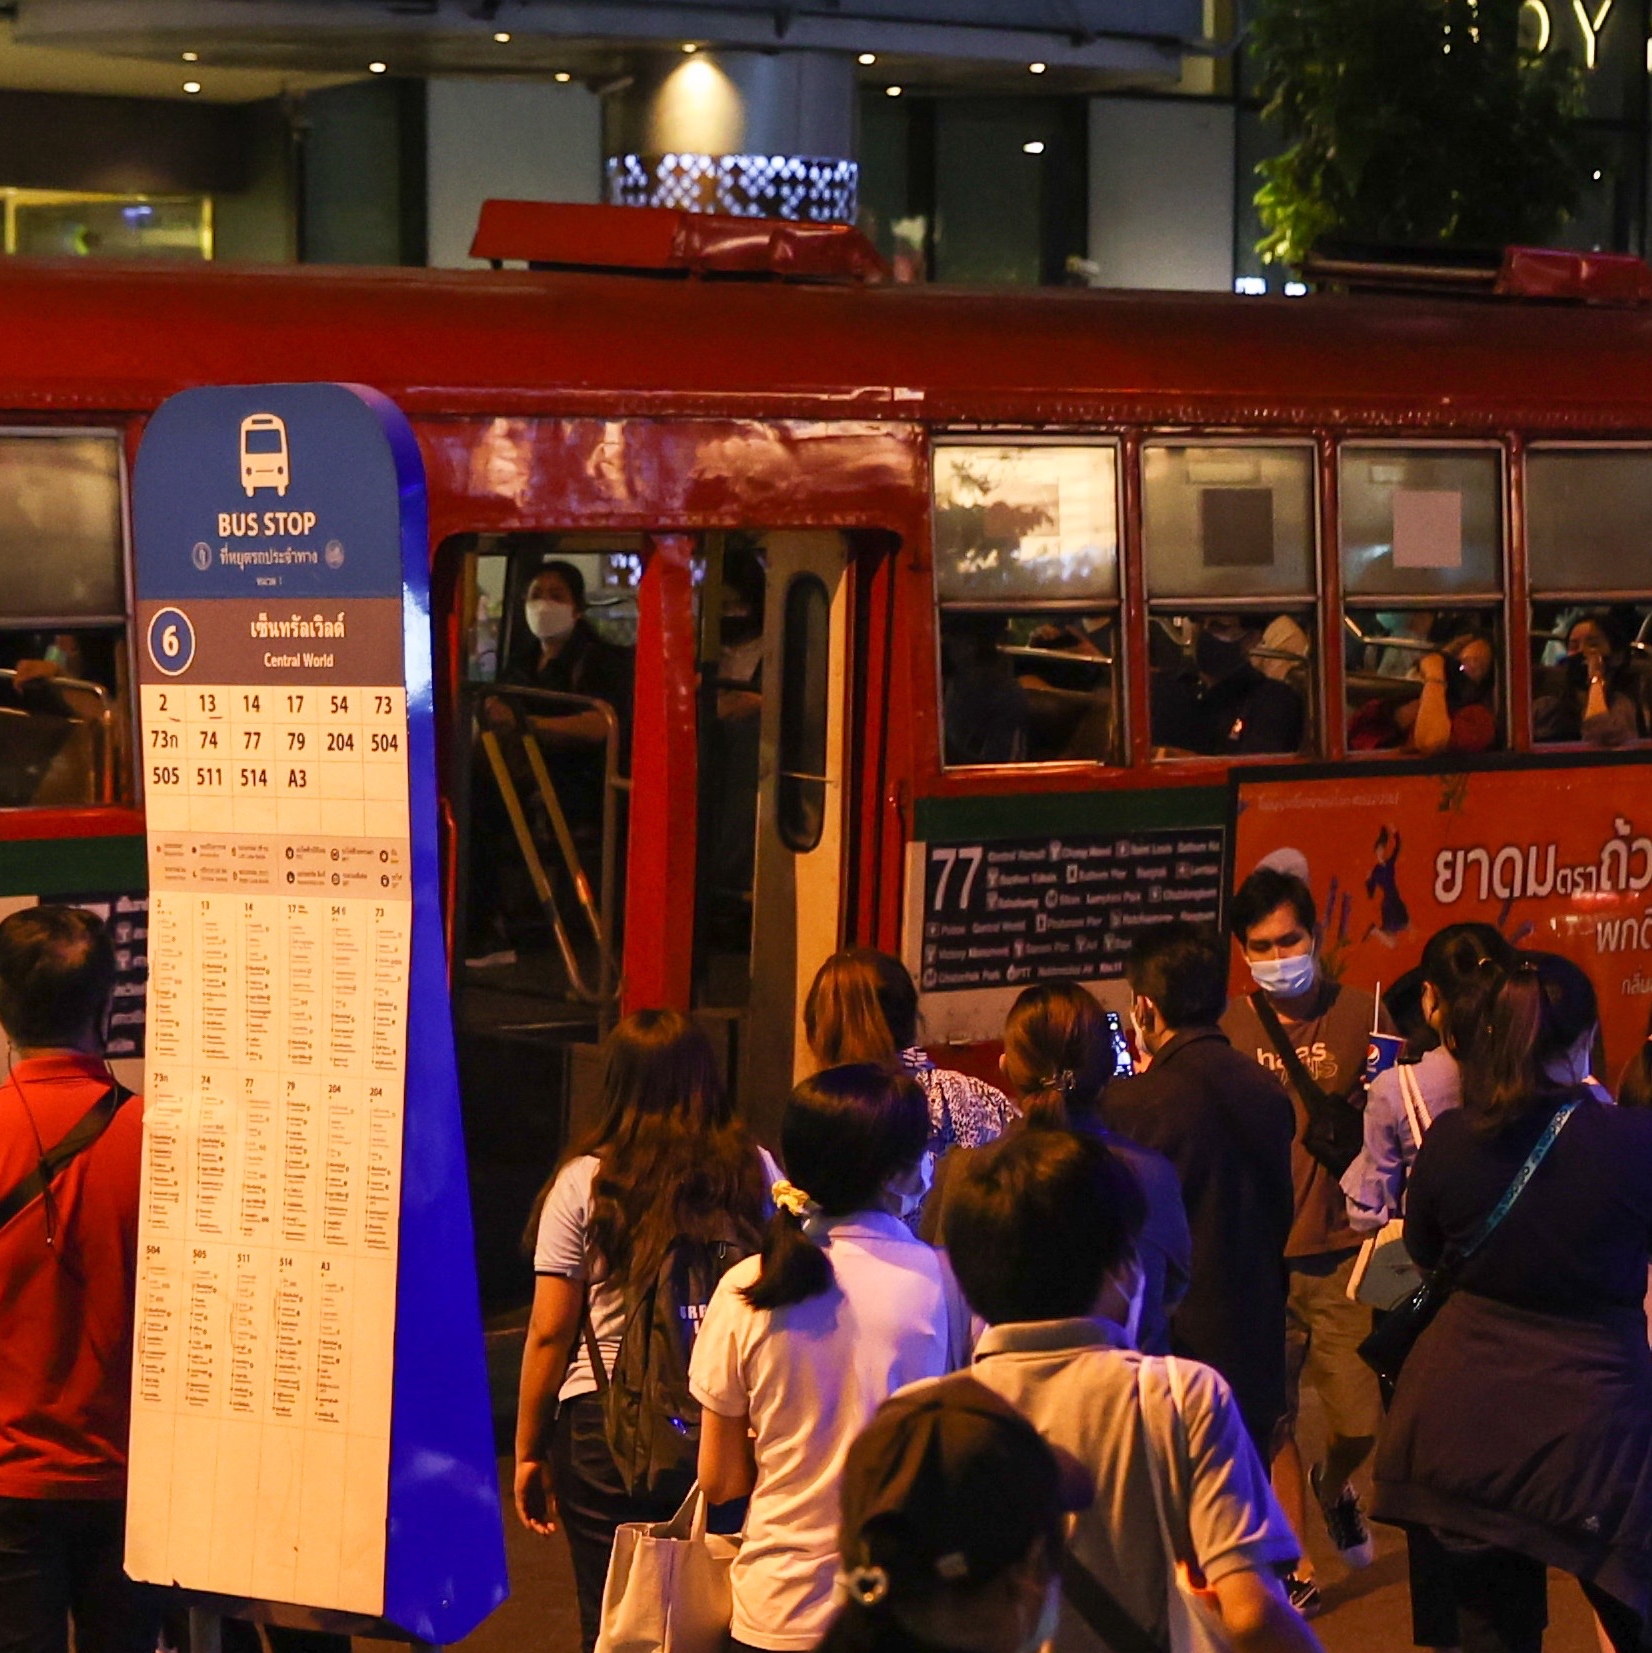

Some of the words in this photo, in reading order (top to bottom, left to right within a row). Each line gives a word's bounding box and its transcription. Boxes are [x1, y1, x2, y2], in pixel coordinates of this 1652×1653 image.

[218, 512, 259, 537] BUS
[263, 511, 317, 536] STOP
[250, 611, 346, 639] เซ็นทรัลเวิลด์
[162, 625, 179, 657] 6
[264, 652, 301, 668] Central
[303, 653, 334, 668] World
[158, 695, 168, 711] 2
[199, 695, 216, 712] 13
[243, 696, 260, 712] 14
[287, 696, 304, 713] 17
[330, 696, 349, 714] 54
[374, 697, 392, 715] 73
[151, 730, 179, 748] 73ก
[200, 731, 218, 749] 74
[244, 732, 261, 749] 77
[287, 733, 305, 750] 79
[327, 733, 354, 752] 204
[371, 734, 398, 752] 504
[153, 767, 180, 785] 505
[197, 768, 222, 786] 511
[241, 769, 268, 787] 514
[288, 769, 307, 787] A3
[931, 846, 984, 912] 77
